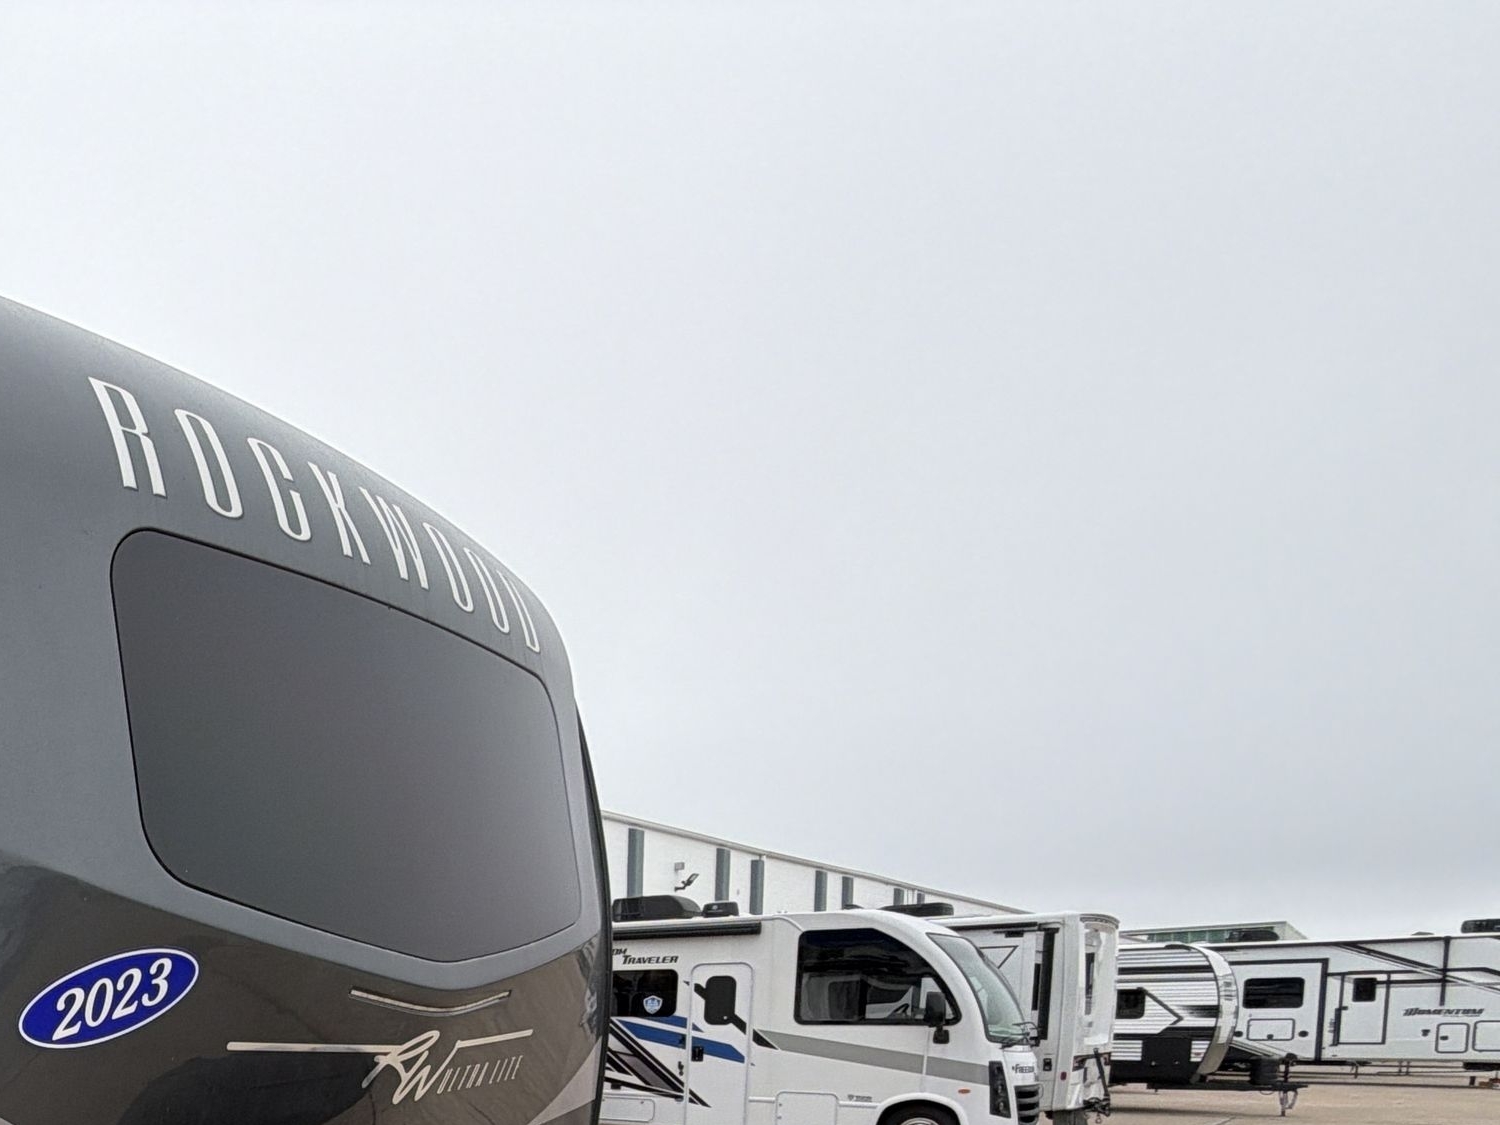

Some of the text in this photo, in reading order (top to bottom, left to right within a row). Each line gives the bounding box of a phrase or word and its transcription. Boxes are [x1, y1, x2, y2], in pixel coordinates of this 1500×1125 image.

[87, 376, 541, 653] ROCKWOOD
[622, 955, 679, 965] TRAVELER
[51, 957, 173, 1041] 2023
[437, 1062, 489, 1095] ULTRA
[489, 1055, 524, 1085] LITE
